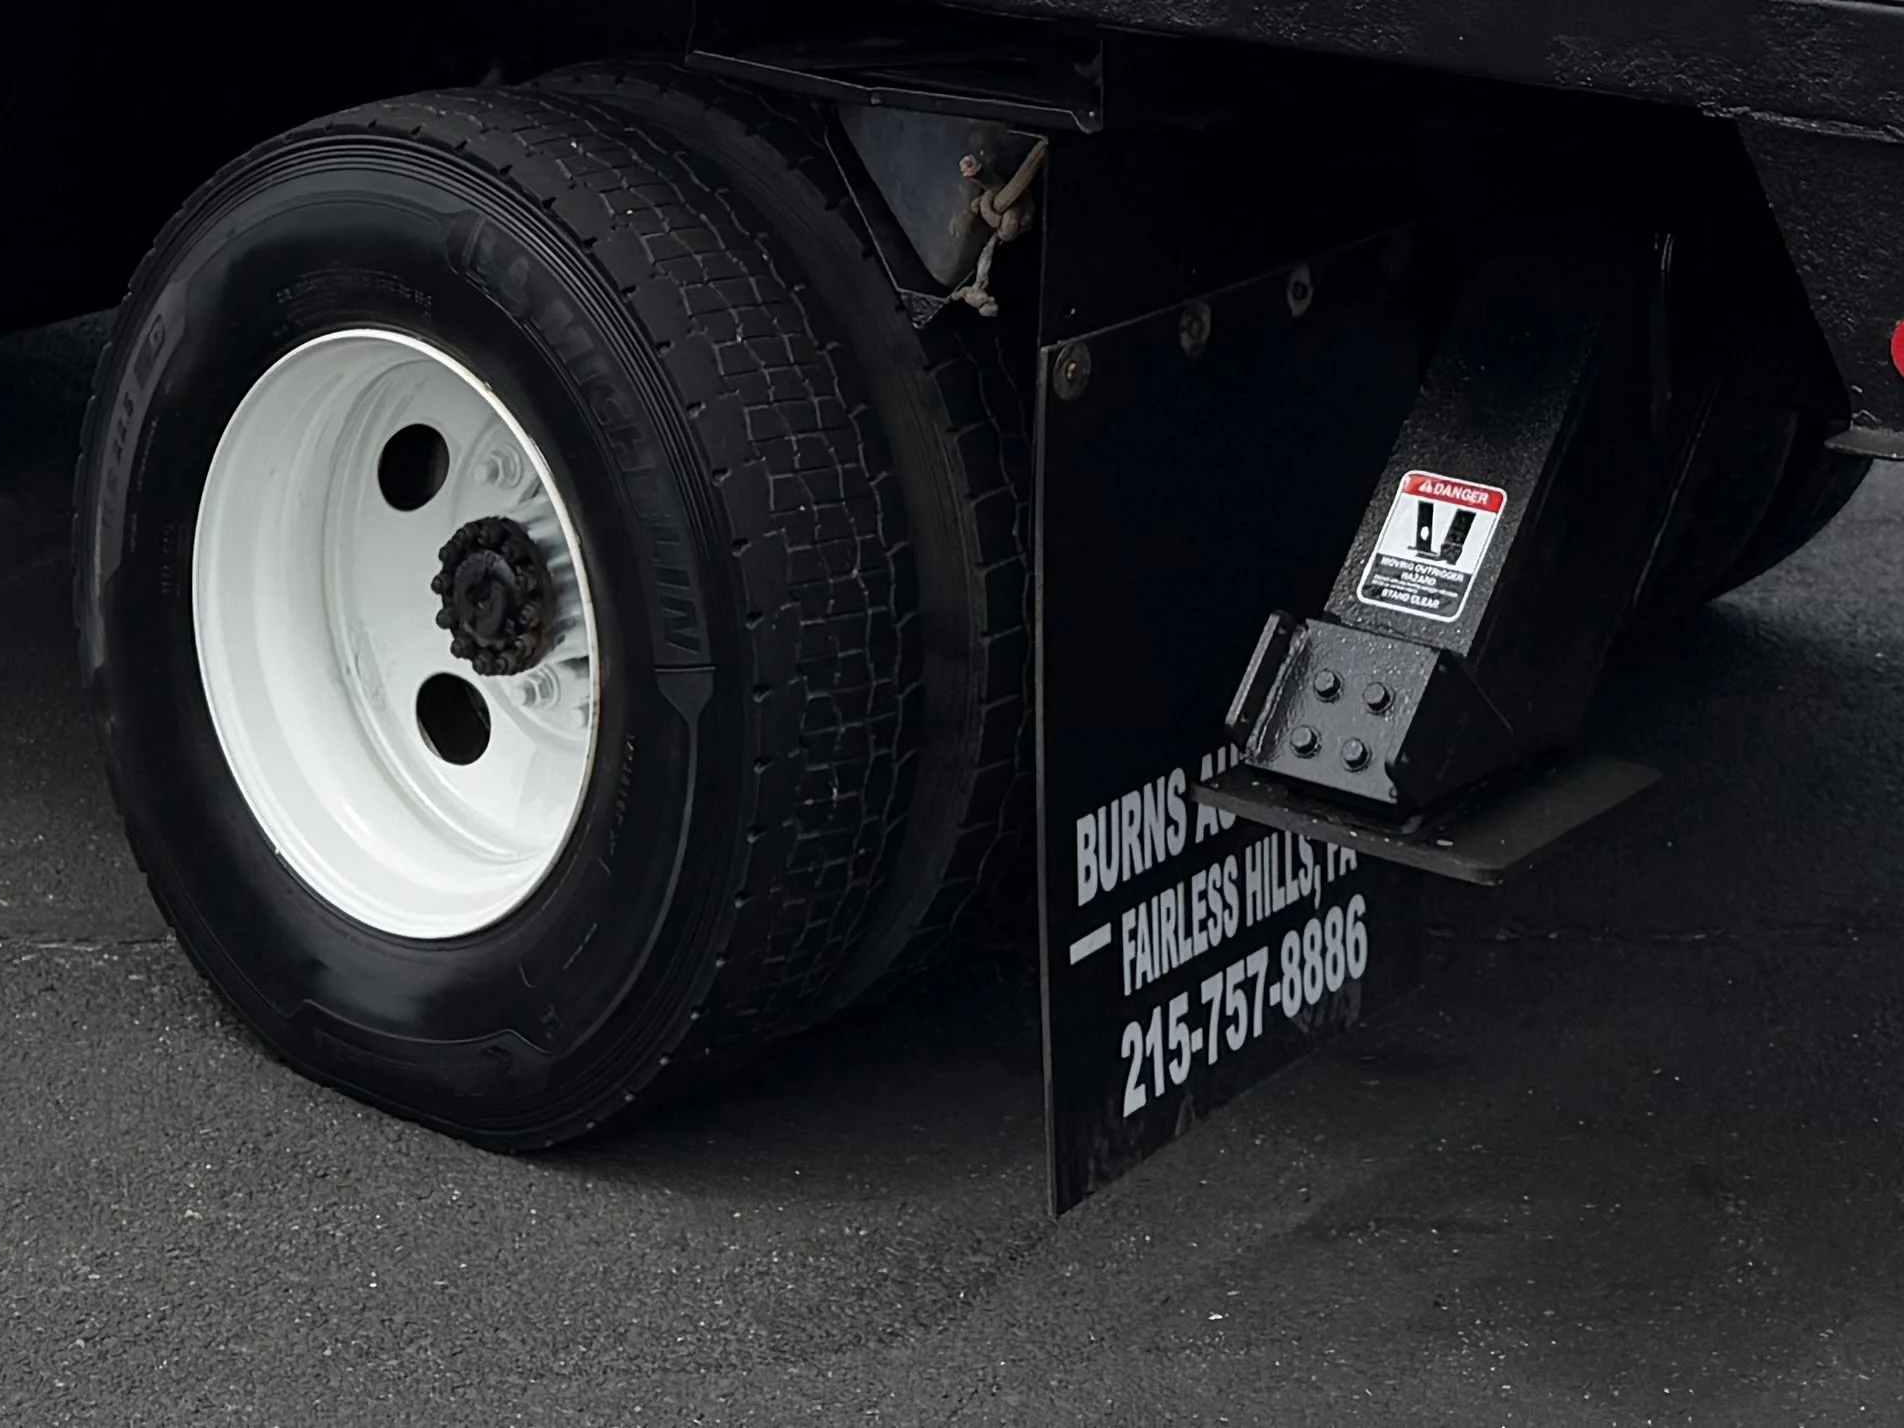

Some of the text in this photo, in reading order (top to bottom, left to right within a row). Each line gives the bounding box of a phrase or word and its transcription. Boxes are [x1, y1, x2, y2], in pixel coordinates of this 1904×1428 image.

[1434, 483, 1489, 505] DANGER
[1380, 557, 1464, 582] MOVING OUTRIGGER
[1401, 572, 1436, 585] HAZARD
[1381, 588, 1440, 609] STAND CLEAR
[1077, 767, 1187, 907] BURNS
[1121, 854, 1240, 996] FAIRLESS
[1244, 830, 1322, 928] HILLS,
[1120, 894, 1369, 1119] 215-757-8886
